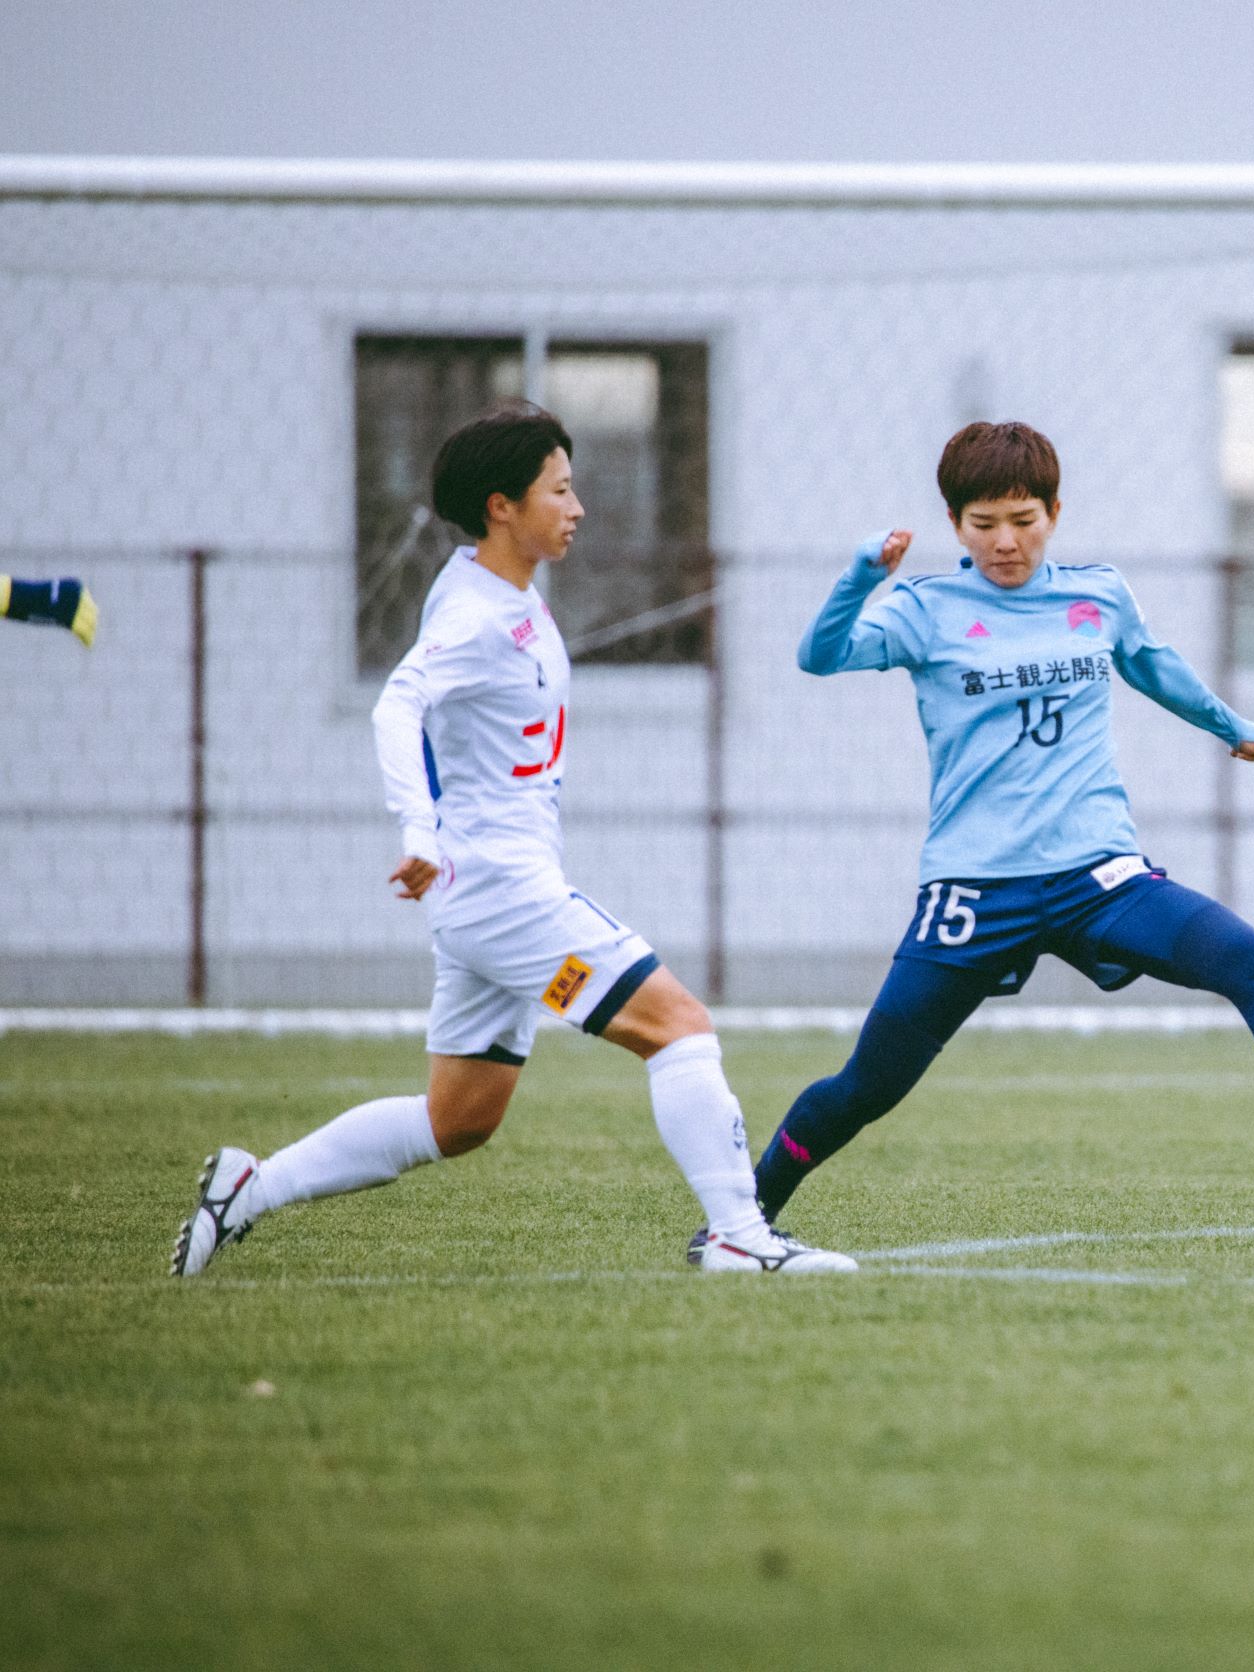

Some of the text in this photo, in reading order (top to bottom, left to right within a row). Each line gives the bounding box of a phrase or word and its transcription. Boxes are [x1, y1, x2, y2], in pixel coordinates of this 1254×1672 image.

[961, 656, 1111, 697] 富士観光開発
[1016, 694, 1070, 747] 15
[916, 882, 982, 946] 15
